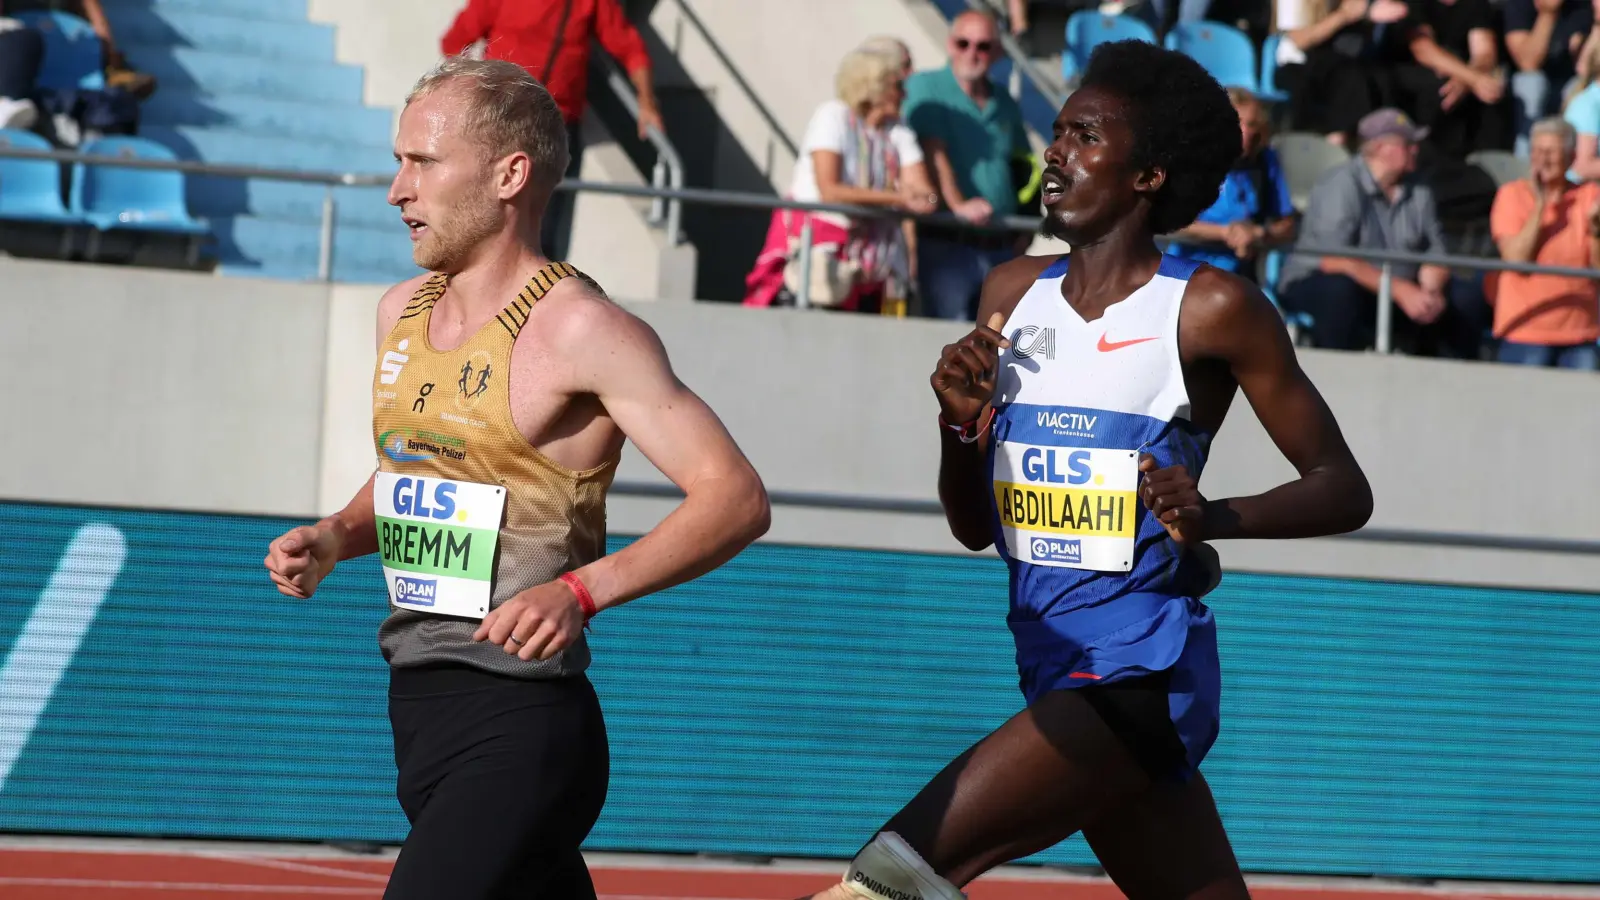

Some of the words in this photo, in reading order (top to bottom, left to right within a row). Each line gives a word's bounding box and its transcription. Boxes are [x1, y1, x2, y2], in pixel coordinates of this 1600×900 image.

[1054, 429, 1094, 438] Krankenkasse
[1003, 487, 1124, 532] ABDILAAHI
[383, 522, 472, 571] BREMM
[1050, 542, 1080, 556] PLAN
[407, 583, 434, 596] PLAN
